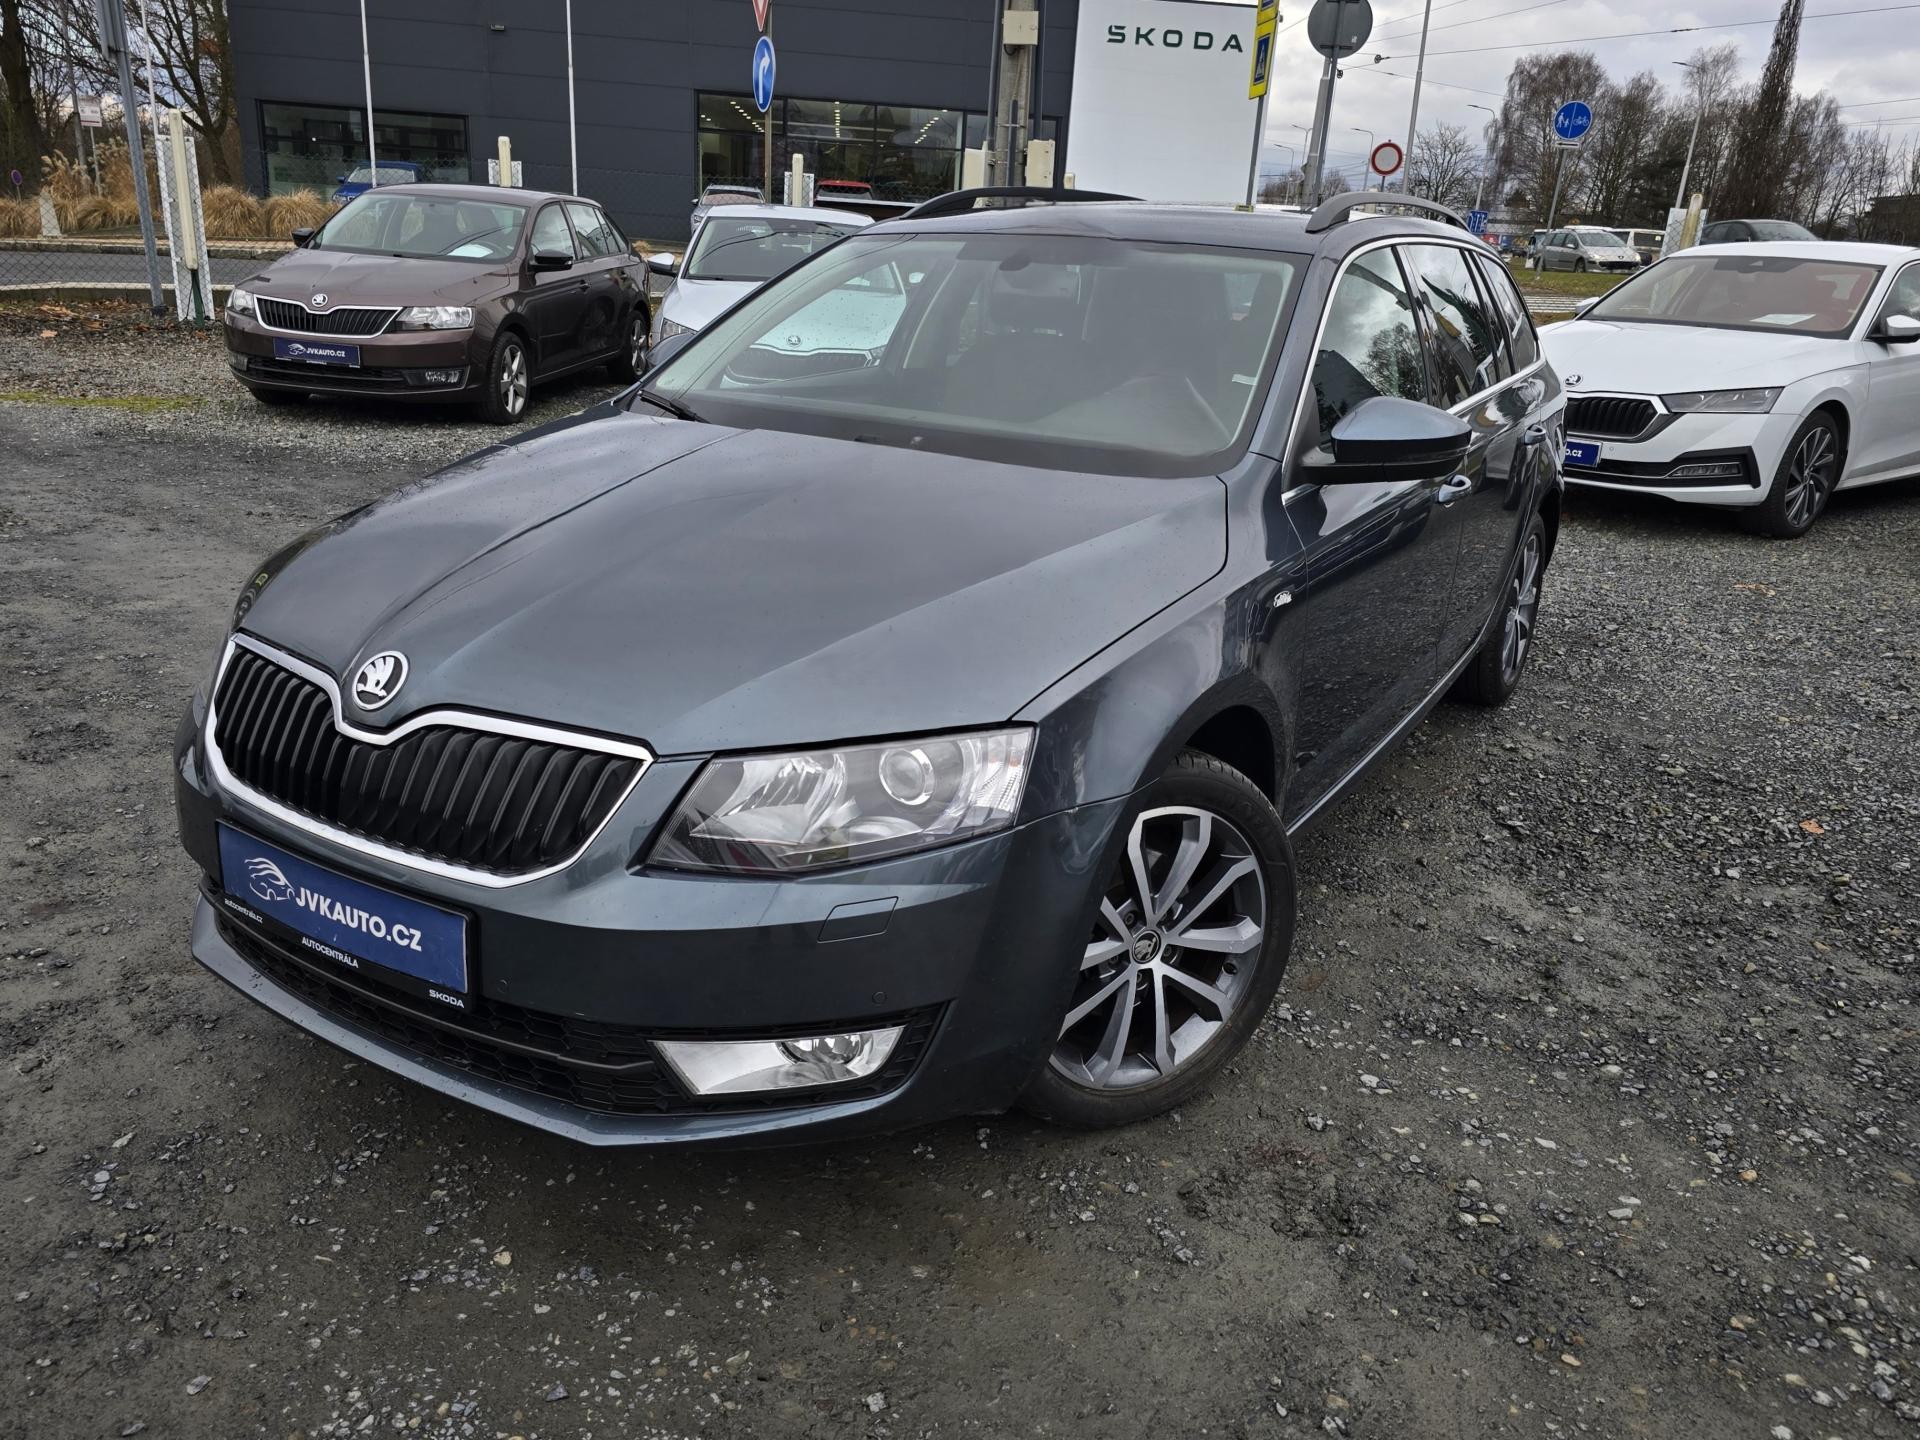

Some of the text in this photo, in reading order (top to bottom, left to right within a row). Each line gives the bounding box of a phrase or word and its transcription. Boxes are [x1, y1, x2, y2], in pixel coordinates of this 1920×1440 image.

[306, 347, 346, 358] JVKAUTO.CZ
[295, 886, 422, 952] JVKAUTO.CZ
[301, 936, 359, 969] AUTOCENTRÁLA
